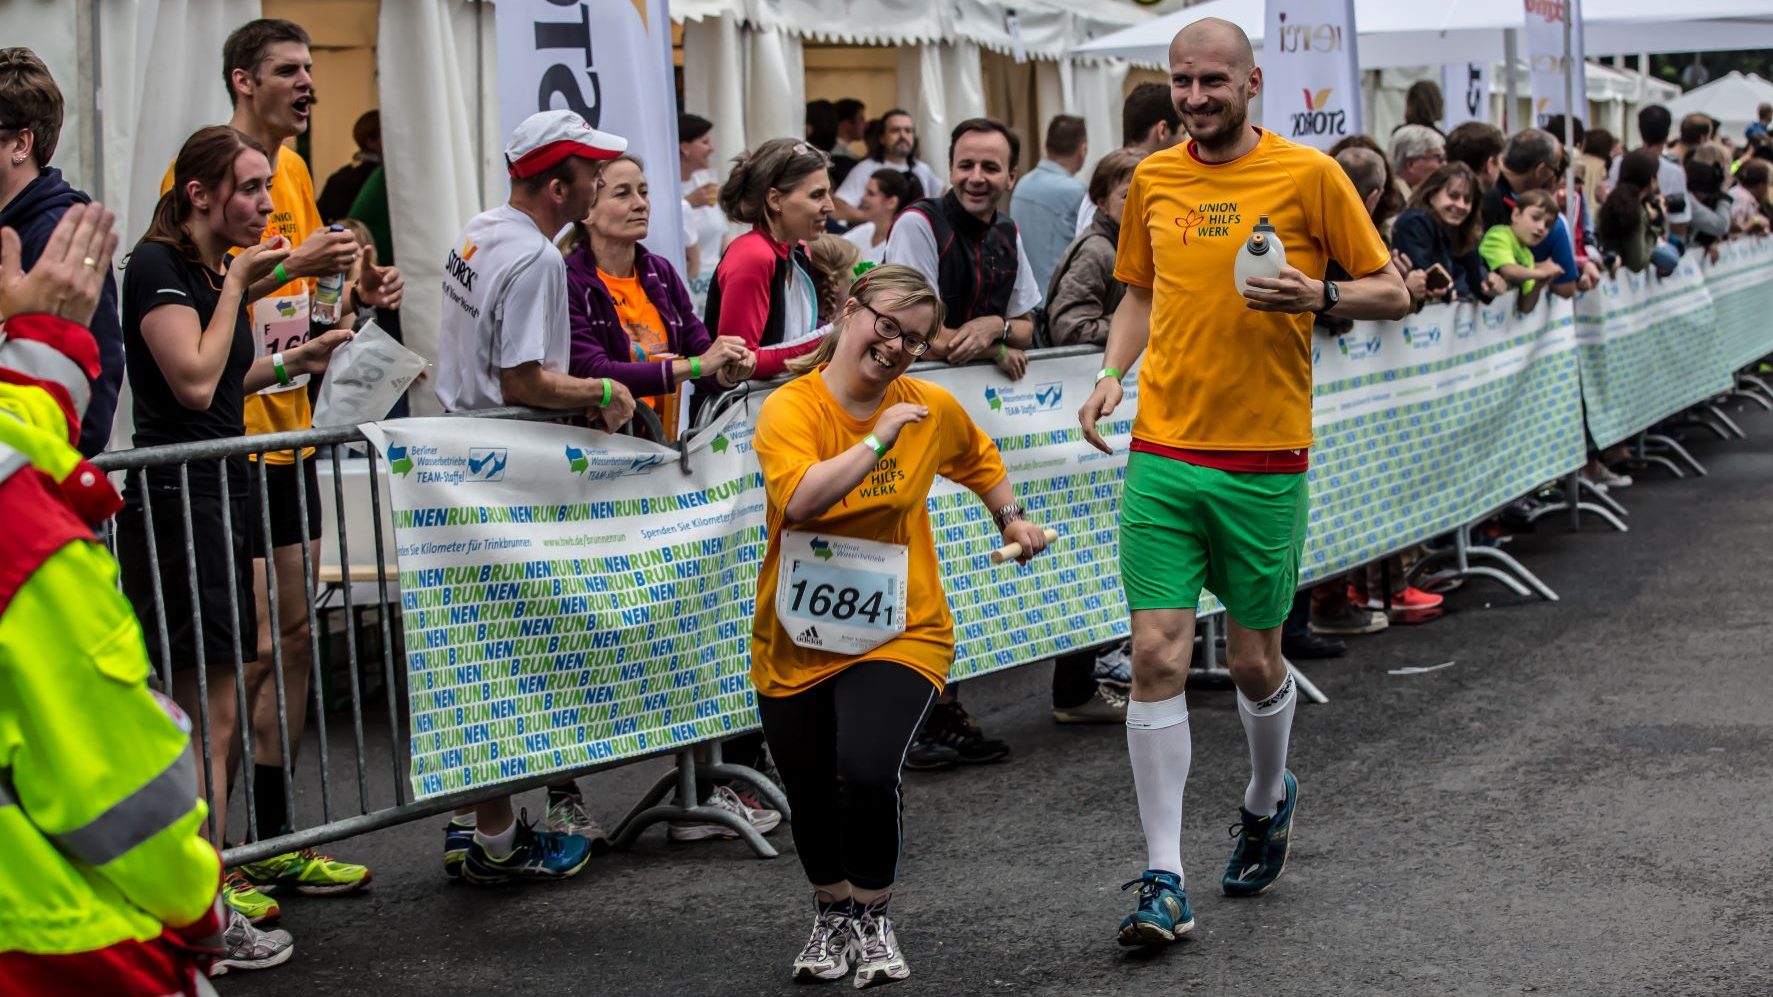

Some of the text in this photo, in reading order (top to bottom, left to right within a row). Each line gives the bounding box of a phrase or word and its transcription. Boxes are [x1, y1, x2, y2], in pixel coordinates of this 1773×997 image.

[1199, 202, 1237, 213] UNION
[1209, 214, 1241, 225] HILFS
[1198, 226, 1229, 237] WERK
[264, 324, 271, 336] F
[411, 445, 438, 455] Berliner
[417, 456, 467, 467] Wasserbetriebe
[417, 470, 465, 486] TEAM-Staffel
[871, 470, 905, 485] HILFS
[859, 484, 897, 498] WERK
[640, 525, 677, 541] Spenden
[677, 521, 691, 533] Sie
[692, 513, 730, 528] Kilometer
[421, 541, 466, 555] Kilometer
[465, 539, 482, 556] für
[484, 537, 532, 551] Trinkbrunnen
[792, 560, 801, 573] F
[791, 580, 883, 624] 1684
[884, 605, 893, 626] 1
[796, 635, 823, 647] adidas
